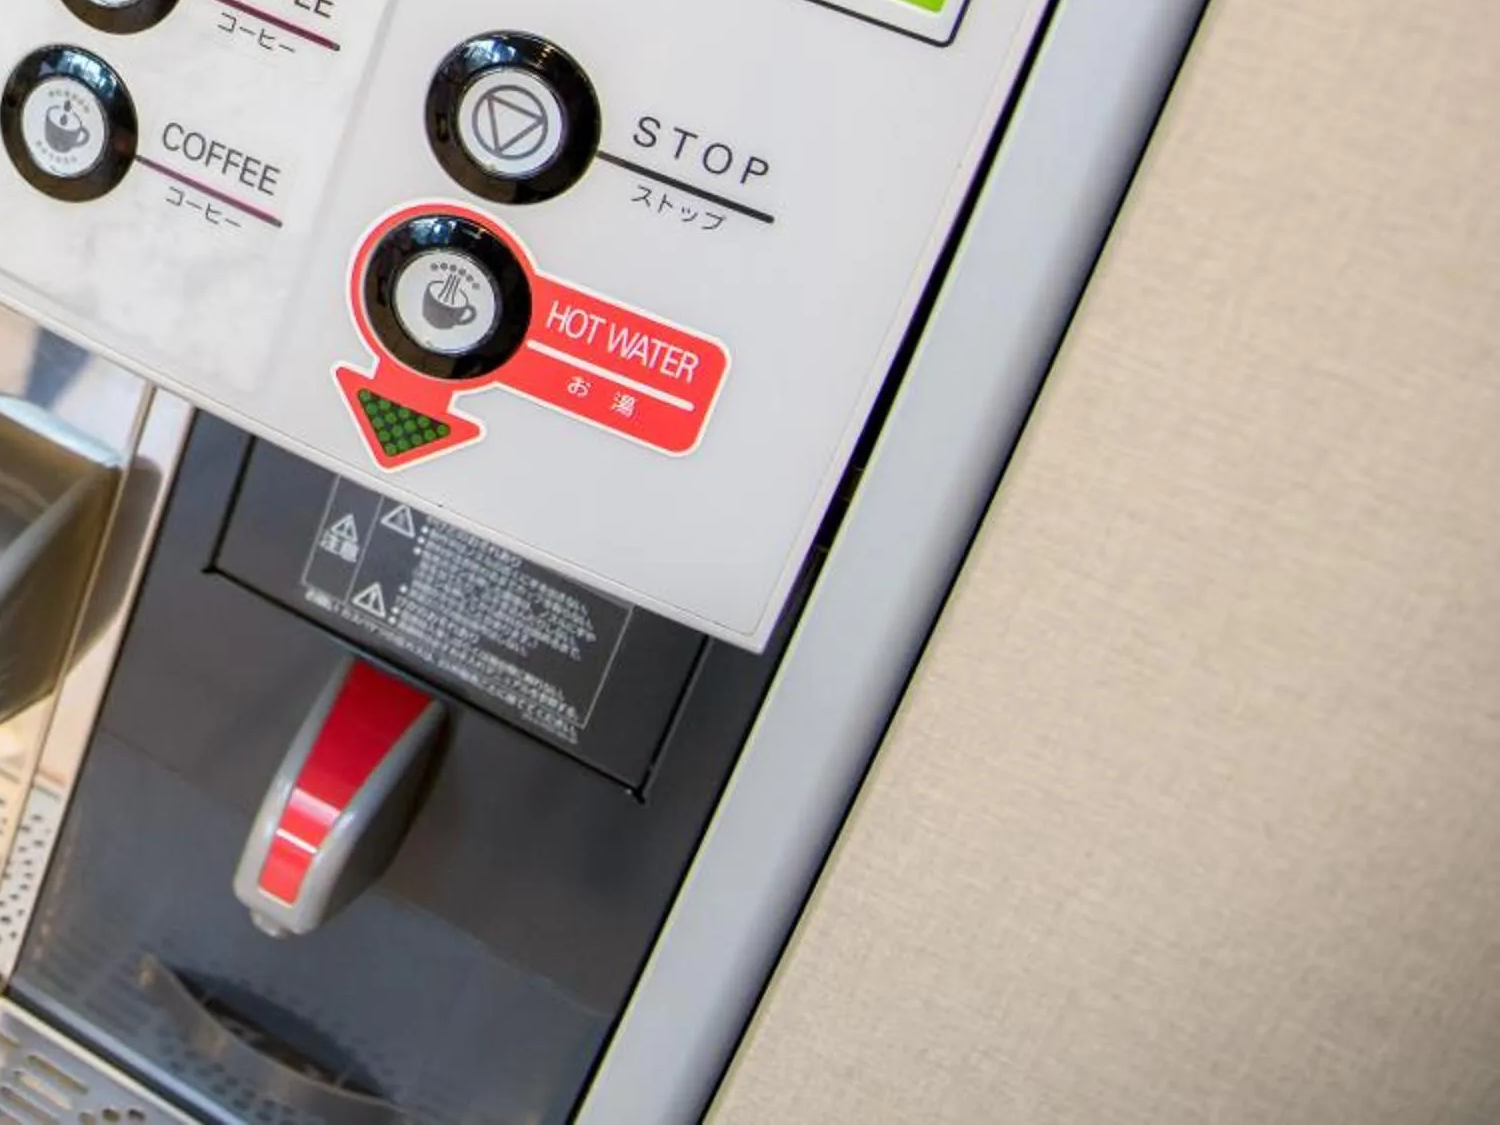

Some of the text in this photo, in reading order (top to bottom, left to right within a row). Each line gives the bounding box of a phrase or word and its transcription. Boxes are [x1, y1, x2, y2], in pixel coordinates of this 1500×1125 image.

[217, 11, 296, 55] コーヒー
[162, 121, 282, 197] COFFEE
[632, 115, 771, 186] STOP
[165, 185, 243, 230] コーヒー
[630, 185, 727, 233] ストップ
[545, 299, 701, 386] HOT WATER
